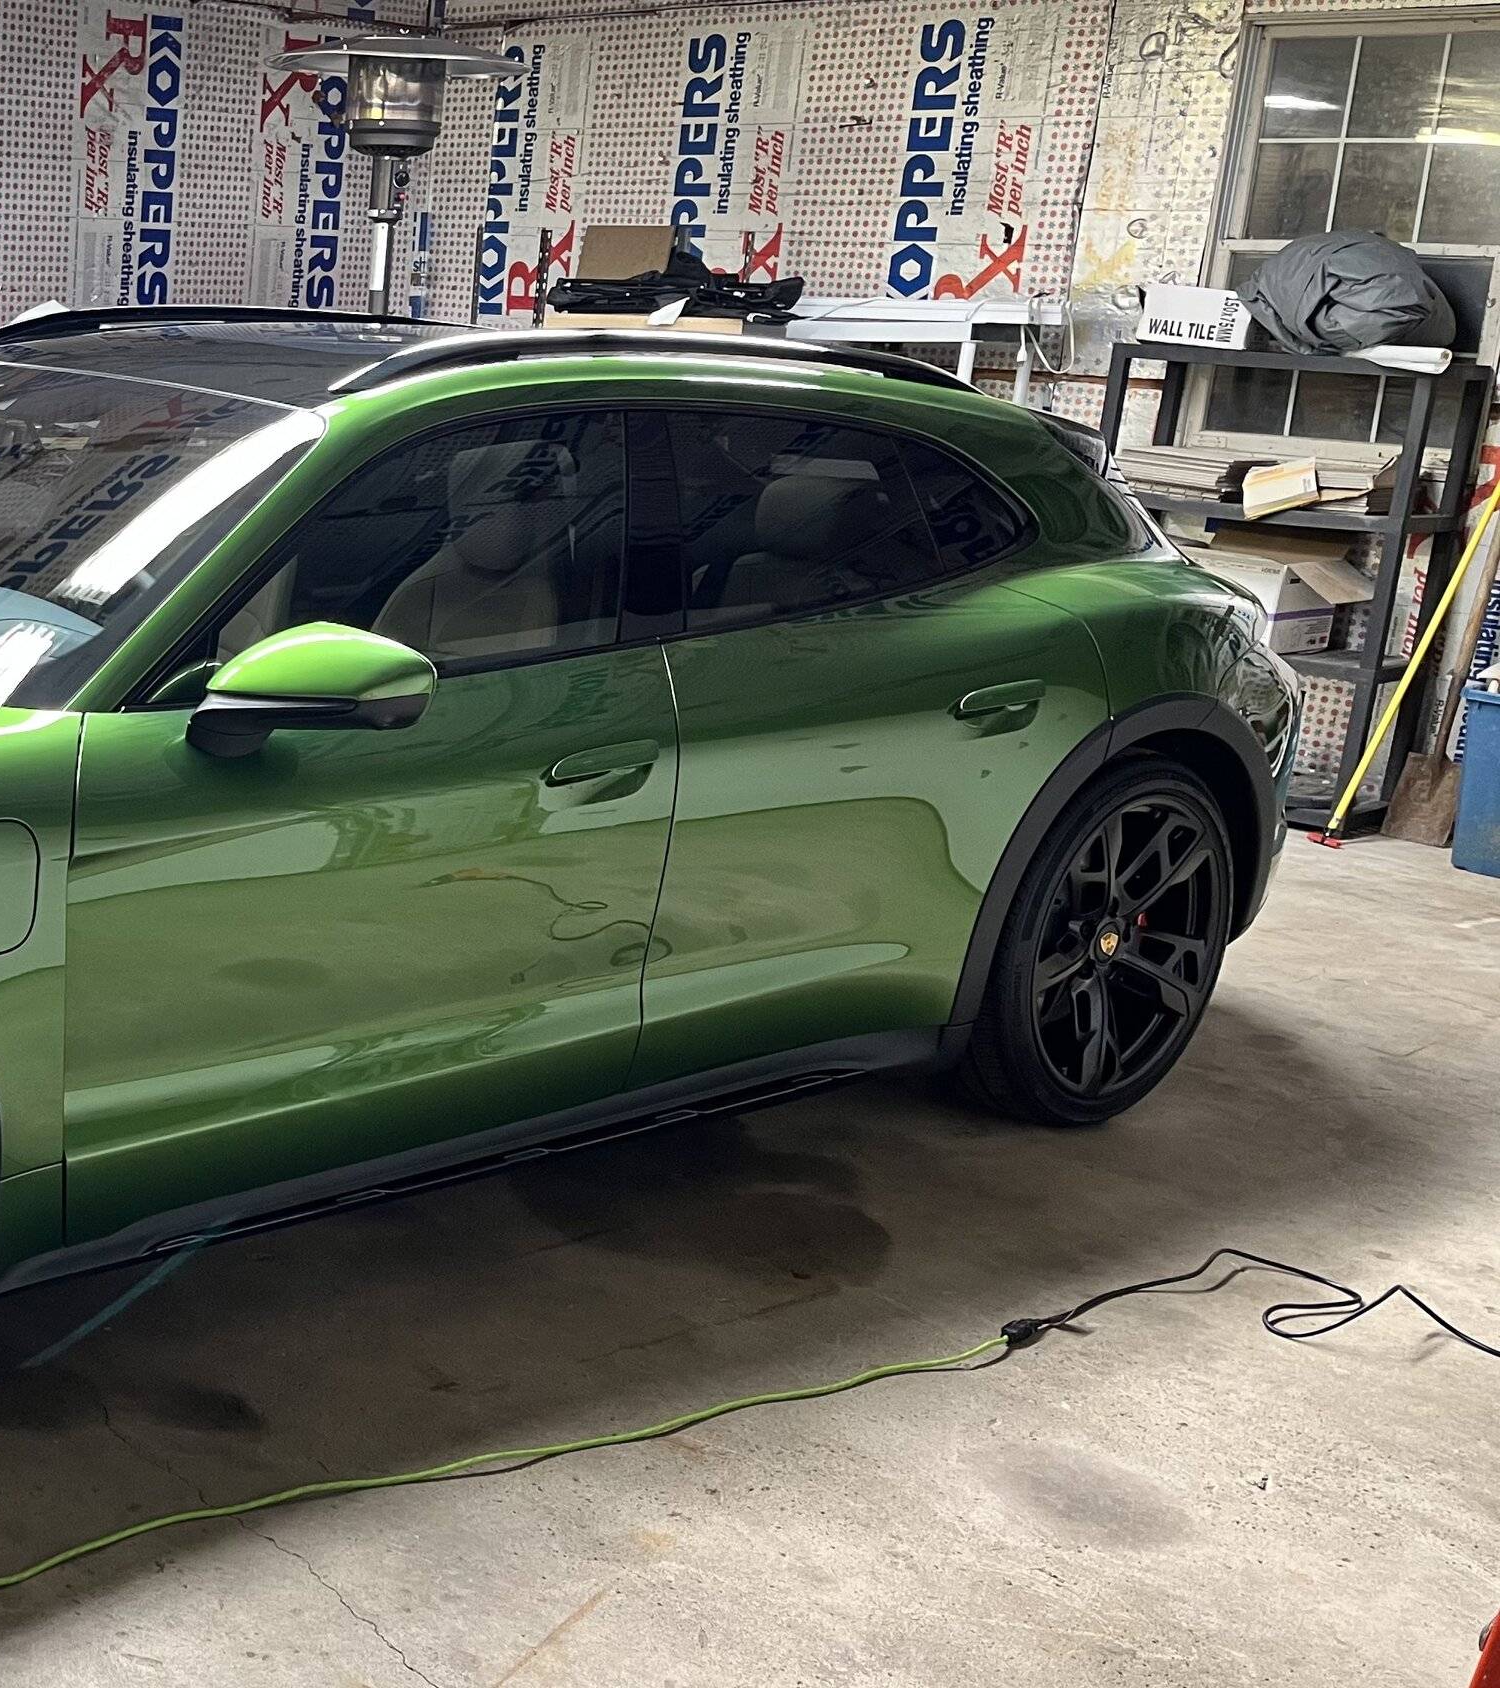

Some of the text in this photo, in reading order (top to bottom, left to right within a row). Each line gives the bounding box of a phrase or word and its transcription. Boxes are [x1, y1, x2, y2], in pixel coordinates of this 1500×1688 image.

[137, 15, 183, 305] KOPPERS
[274, 138, 286, 188] Most
[515, 44, 545, 213] insulating sheathing
[671, 33, 727, 258] PPERS
[713, 32, 751, 214] insulating sheathing
[886, 19, 966, 300] OPPERS
[946, 17, 995, 216] insulating sheathing
[85, 125, 99, 212] per inch
[262, 139, 275, 219] per inch
[306, 36, 349, 309] OPPERS
[545, 165, 559, 213] Most
[560, 135, 576, 214] per inch
[748, 170, 766, 216] Most
[765, 130, 785, 216] per inch
[987, 162, 1009, 217] Most
[1008, 124, 1032, 219] per inch
[117, 130, 141, 306] insulating sheathing
[288, 143, 313, 308] insulating sheathing
[1148, 318, 1216, 341] WALL TILE
